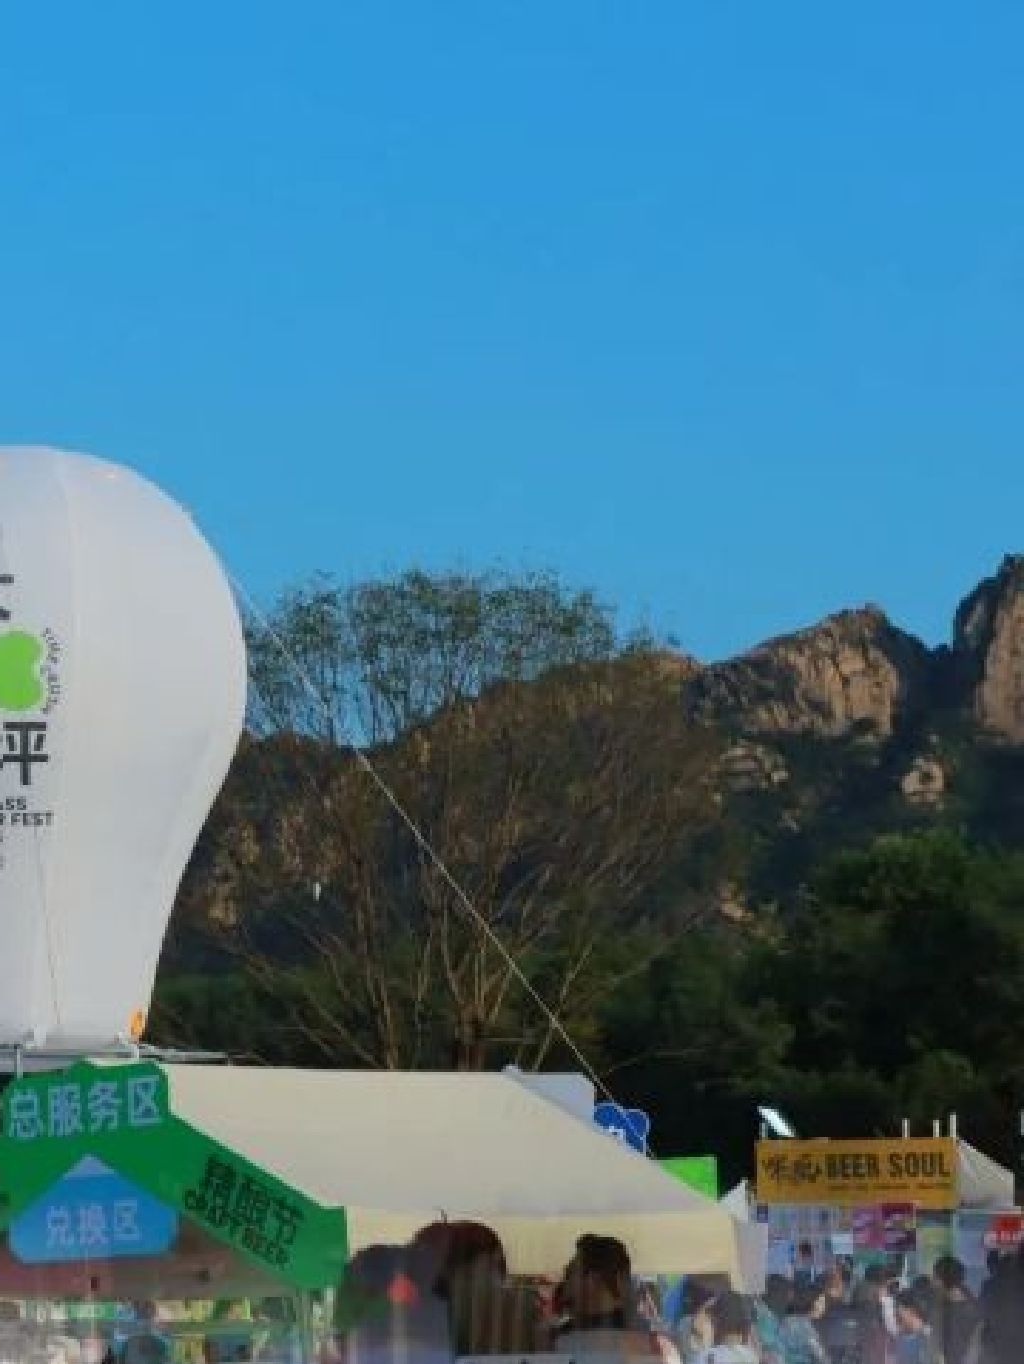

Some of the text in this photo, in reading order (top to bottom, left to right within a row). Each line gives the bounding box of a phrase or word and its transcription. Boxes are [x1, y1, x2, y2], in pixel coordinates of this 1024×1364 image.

[10, 812, 54, 828] FEST
[9, 1073, 162, 1138] 总服务区
[825, 1152, 880, 1179] BEER
[888, 1151, 952, 1179] SOUL
[45, 1199, 143, 1248] 兑换区
